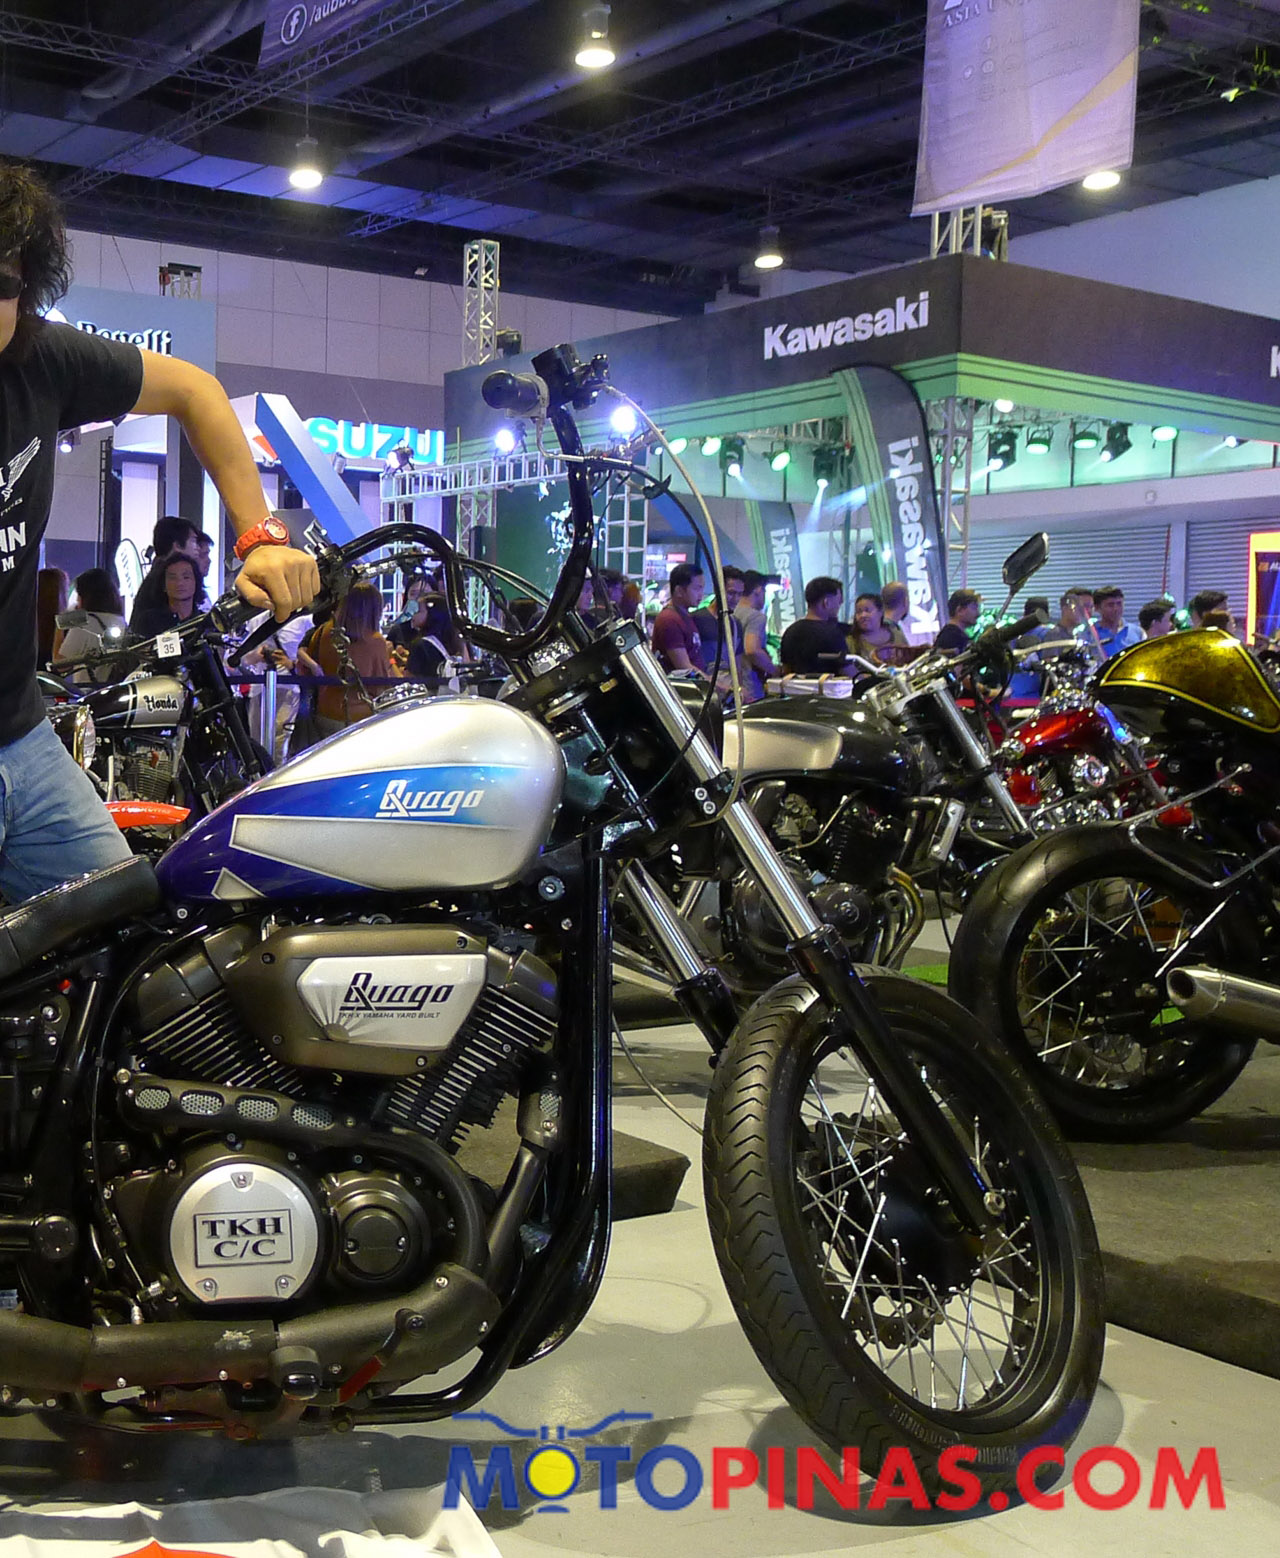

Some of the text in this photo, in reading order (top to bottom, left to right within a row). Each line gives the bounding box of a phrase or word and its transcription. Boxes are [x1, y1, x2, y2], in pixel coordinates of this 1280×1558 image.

[764, 291, 929, 360] Kawasaki
[298, 416, 445, 466] SUZU
[888, 436, 940, 634] Kawasaki
[163, 644, 175, 655] 35
[143, 694, 178, 712] Honda
[201, 1216, 285, 1240] TKH
[213, 1238, 276, 1260] C/C
